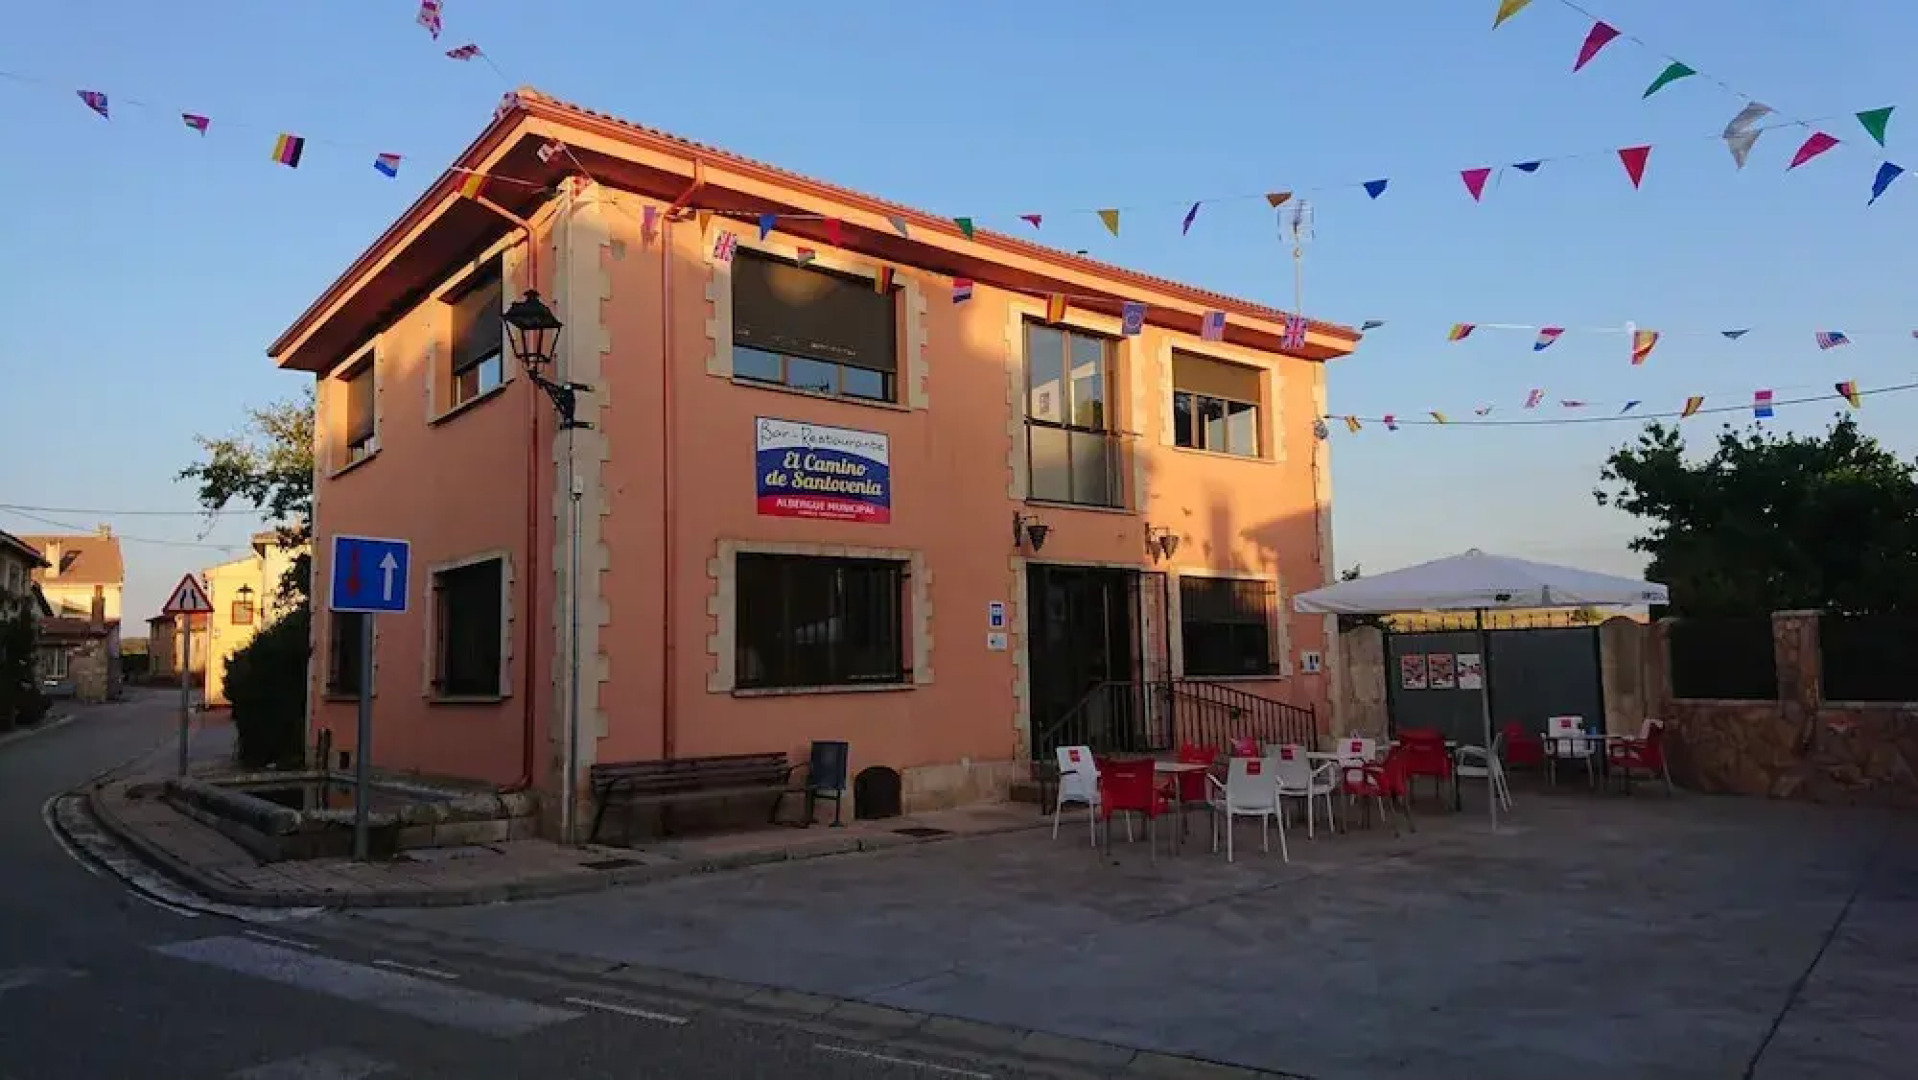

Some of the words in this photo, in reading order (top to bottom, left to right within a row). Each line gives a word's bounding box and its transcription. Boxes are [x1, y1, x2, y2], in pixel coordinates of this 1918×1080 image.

[783, 450, 800, 470] El
[804, 453, 867, 476] Camino
[765, 470, 788, 488] de
[792, 471, 882, 495] Santovenia
[776, 498, 825, 511] ALBERGUE
[827, 501, 876, 515] MUNICIPAL
